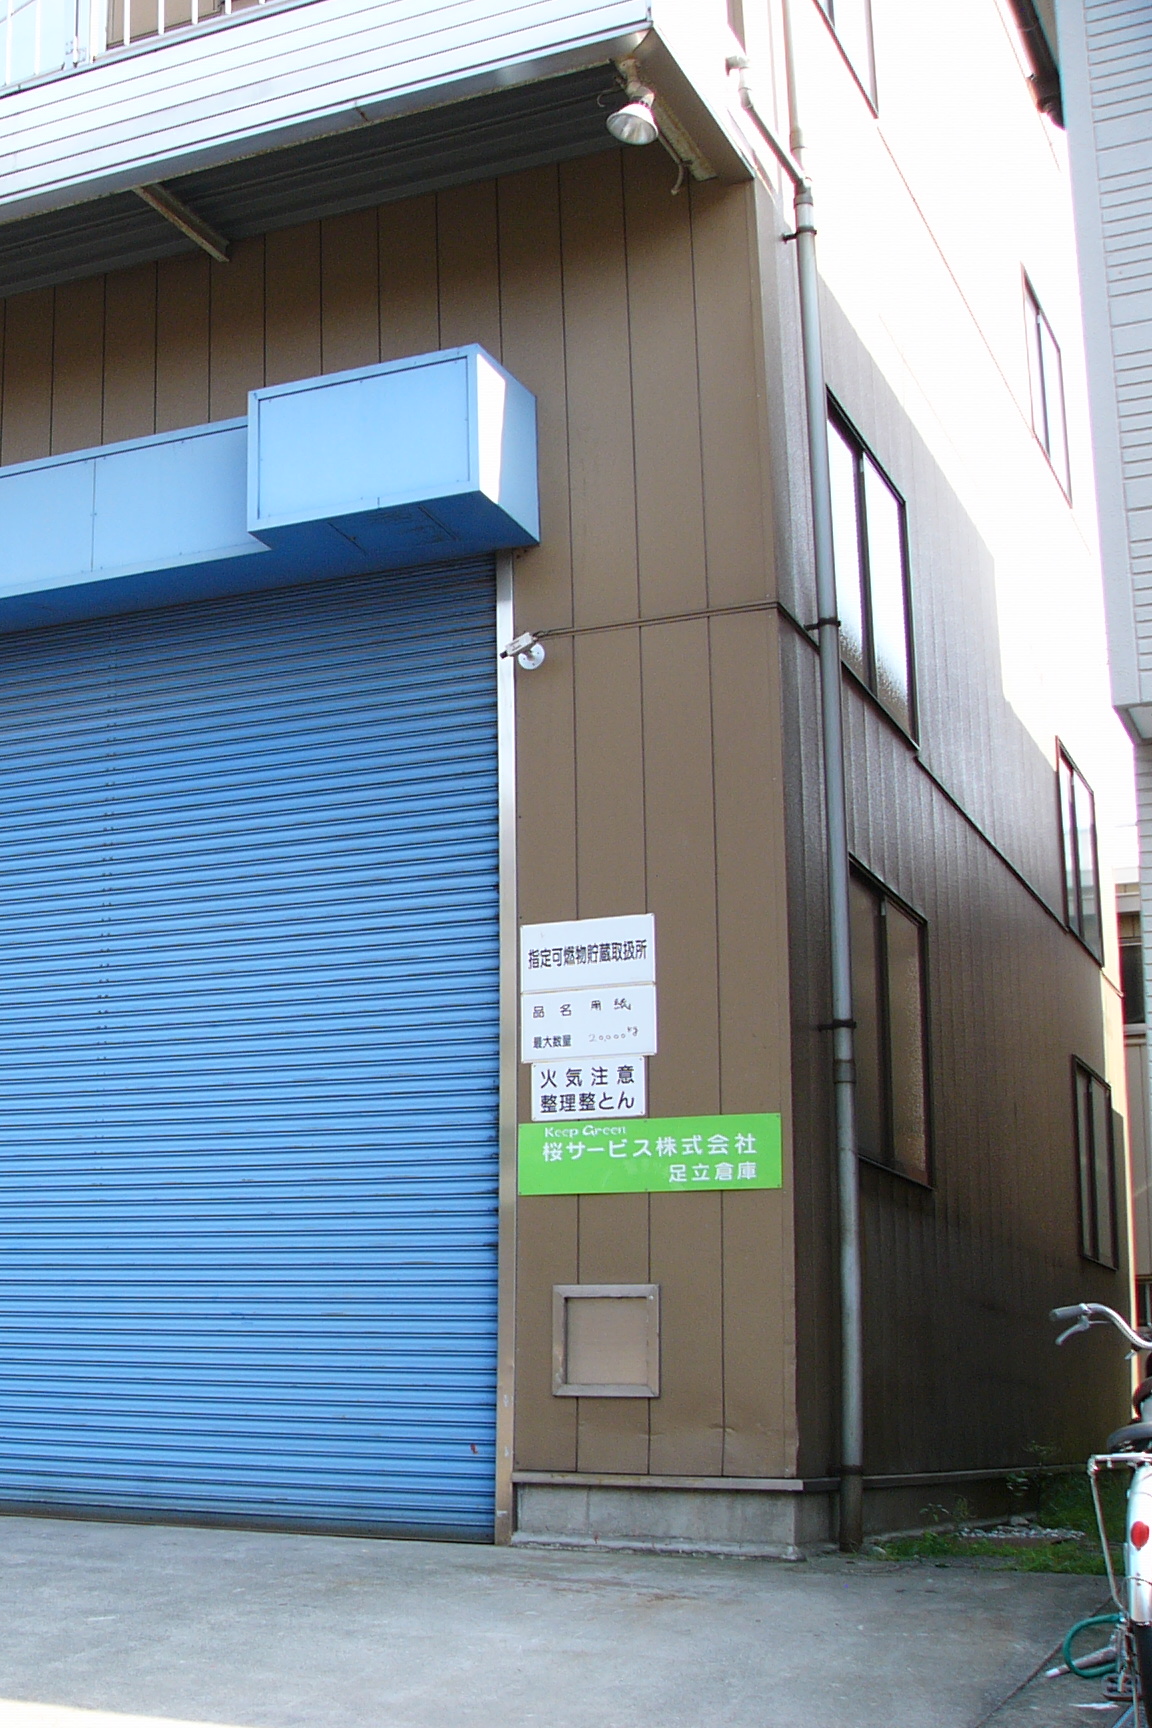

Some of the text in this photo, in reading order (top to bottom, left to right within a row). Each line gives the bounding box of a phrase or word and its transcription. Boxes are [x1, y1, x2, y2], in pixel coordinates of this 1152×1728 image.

[527, 939, 648, 970] 指定可燃物貯蔵取扱所
[532, 1003, 573, 1019] 品名
[532, 1034, 572, 1049] 最大数量
[539, 1064, 635, 1089] 火気注意
[539, 1091, 635, 1114] 整理整とん
[544, 1124, 627, 1138] Keep Green
[542, 1132, 758, 1163] 桜サービス株式会社
[668, 1161, 758, 1183] 足立倉庫
